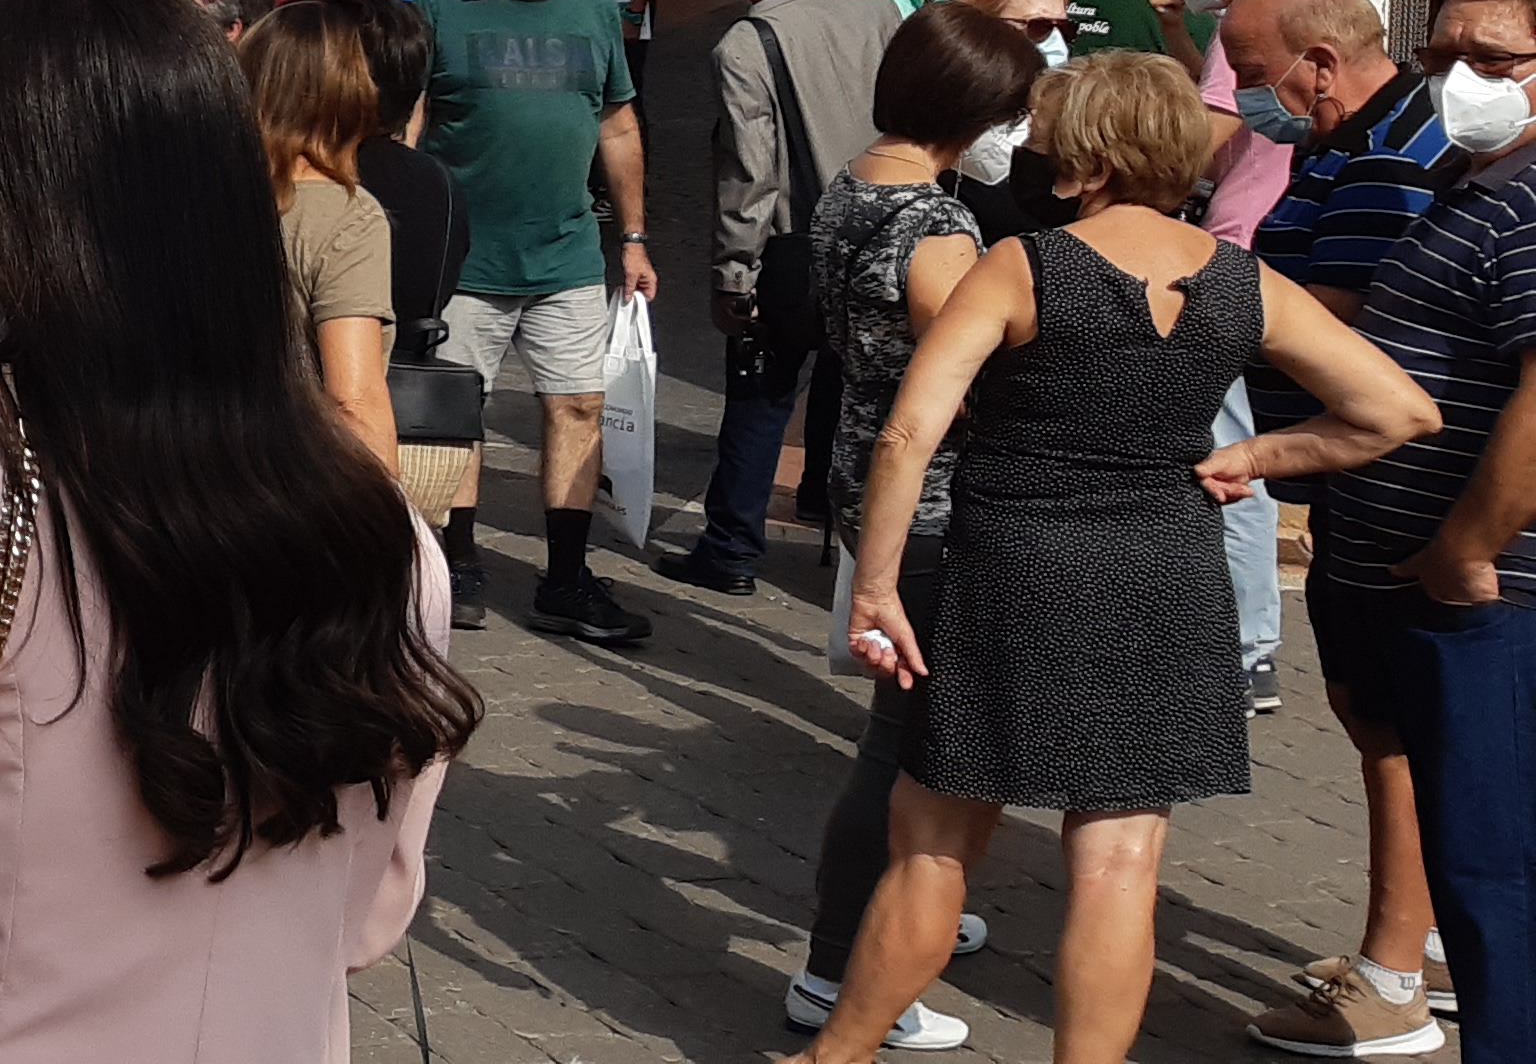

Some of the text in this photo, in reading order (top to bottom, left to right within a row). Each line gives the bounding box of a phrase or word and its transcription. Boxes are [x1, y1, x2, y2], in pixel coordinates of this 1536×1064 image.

[1067, 1, 1097, 16] ltura
[1077, 20, 1110, 35] poble
[599, 415, 635, 433] ancia
